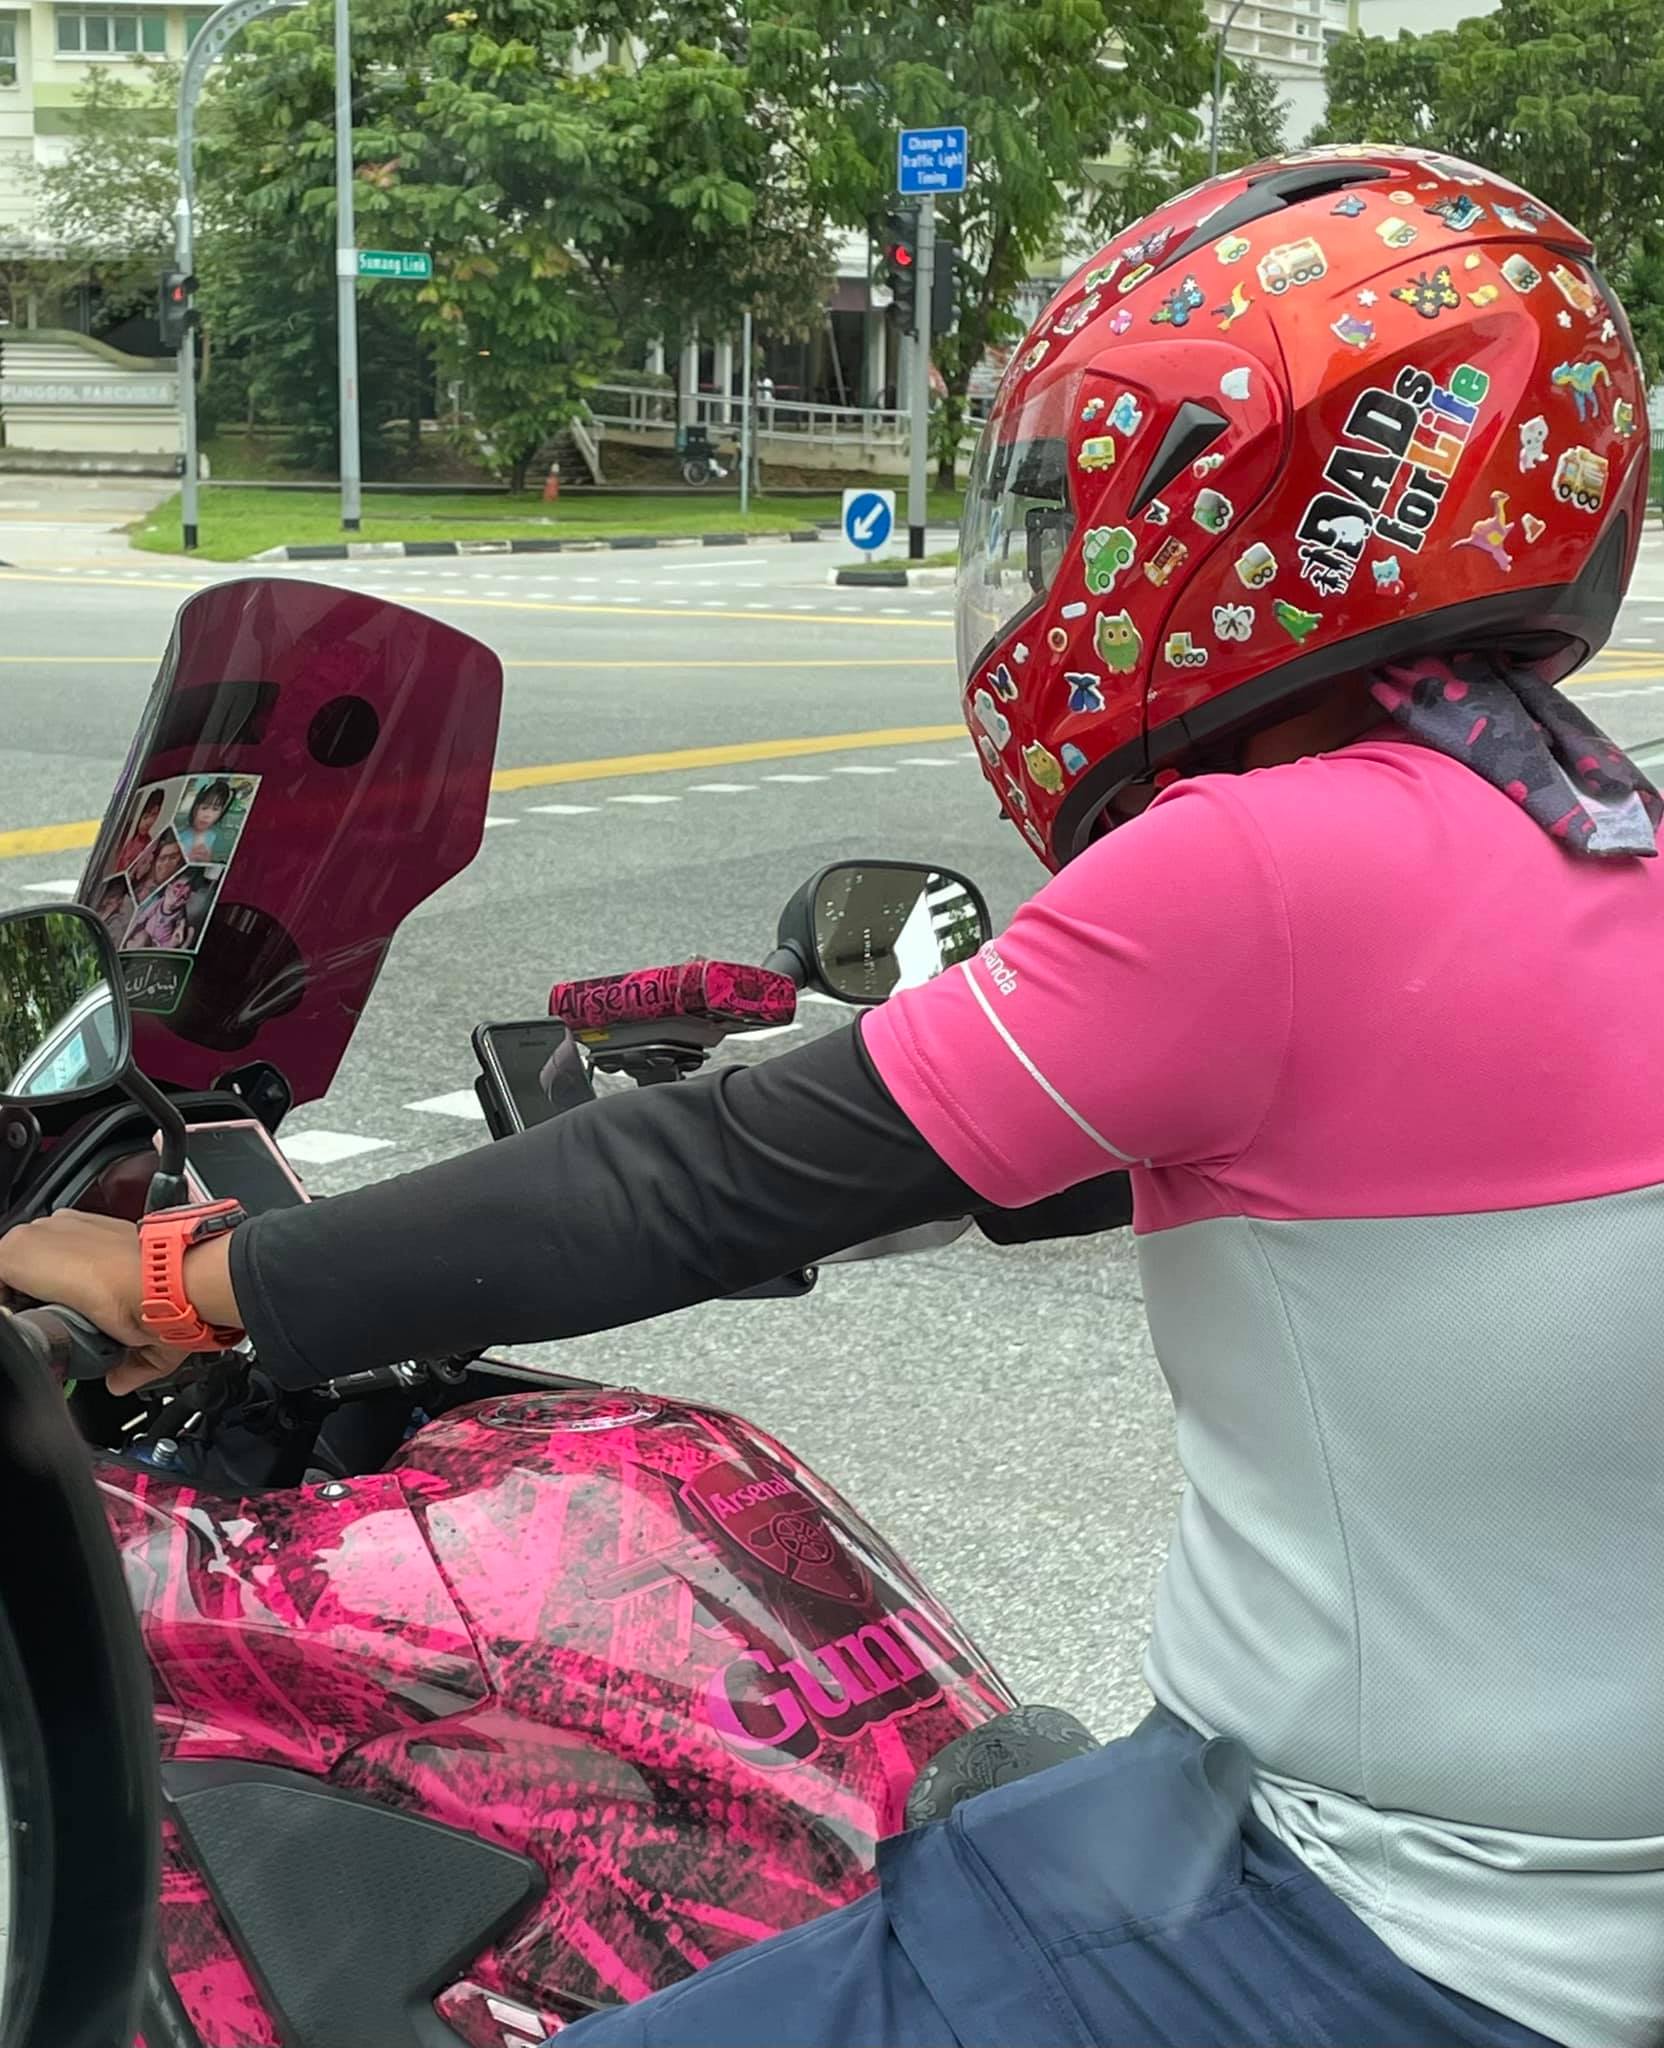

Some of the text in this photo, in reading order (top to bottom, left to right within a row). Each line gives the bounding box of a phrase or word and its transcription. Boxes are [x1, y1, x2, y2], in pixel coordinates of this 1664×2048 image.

[907, 136, 944, 152] Change
[902, 152, 963, 168] Traffic Light
[917, 171, 948, 187] Timing
[359, 253, 426, 275] Sumang Link
[0, 384, 80, 400] PUNGGOL
[1403, 363, 1489, 479] Life
[557, 969, 672, 1019] Arsenal
[709, 1472, 797, 1520] Arsenal
